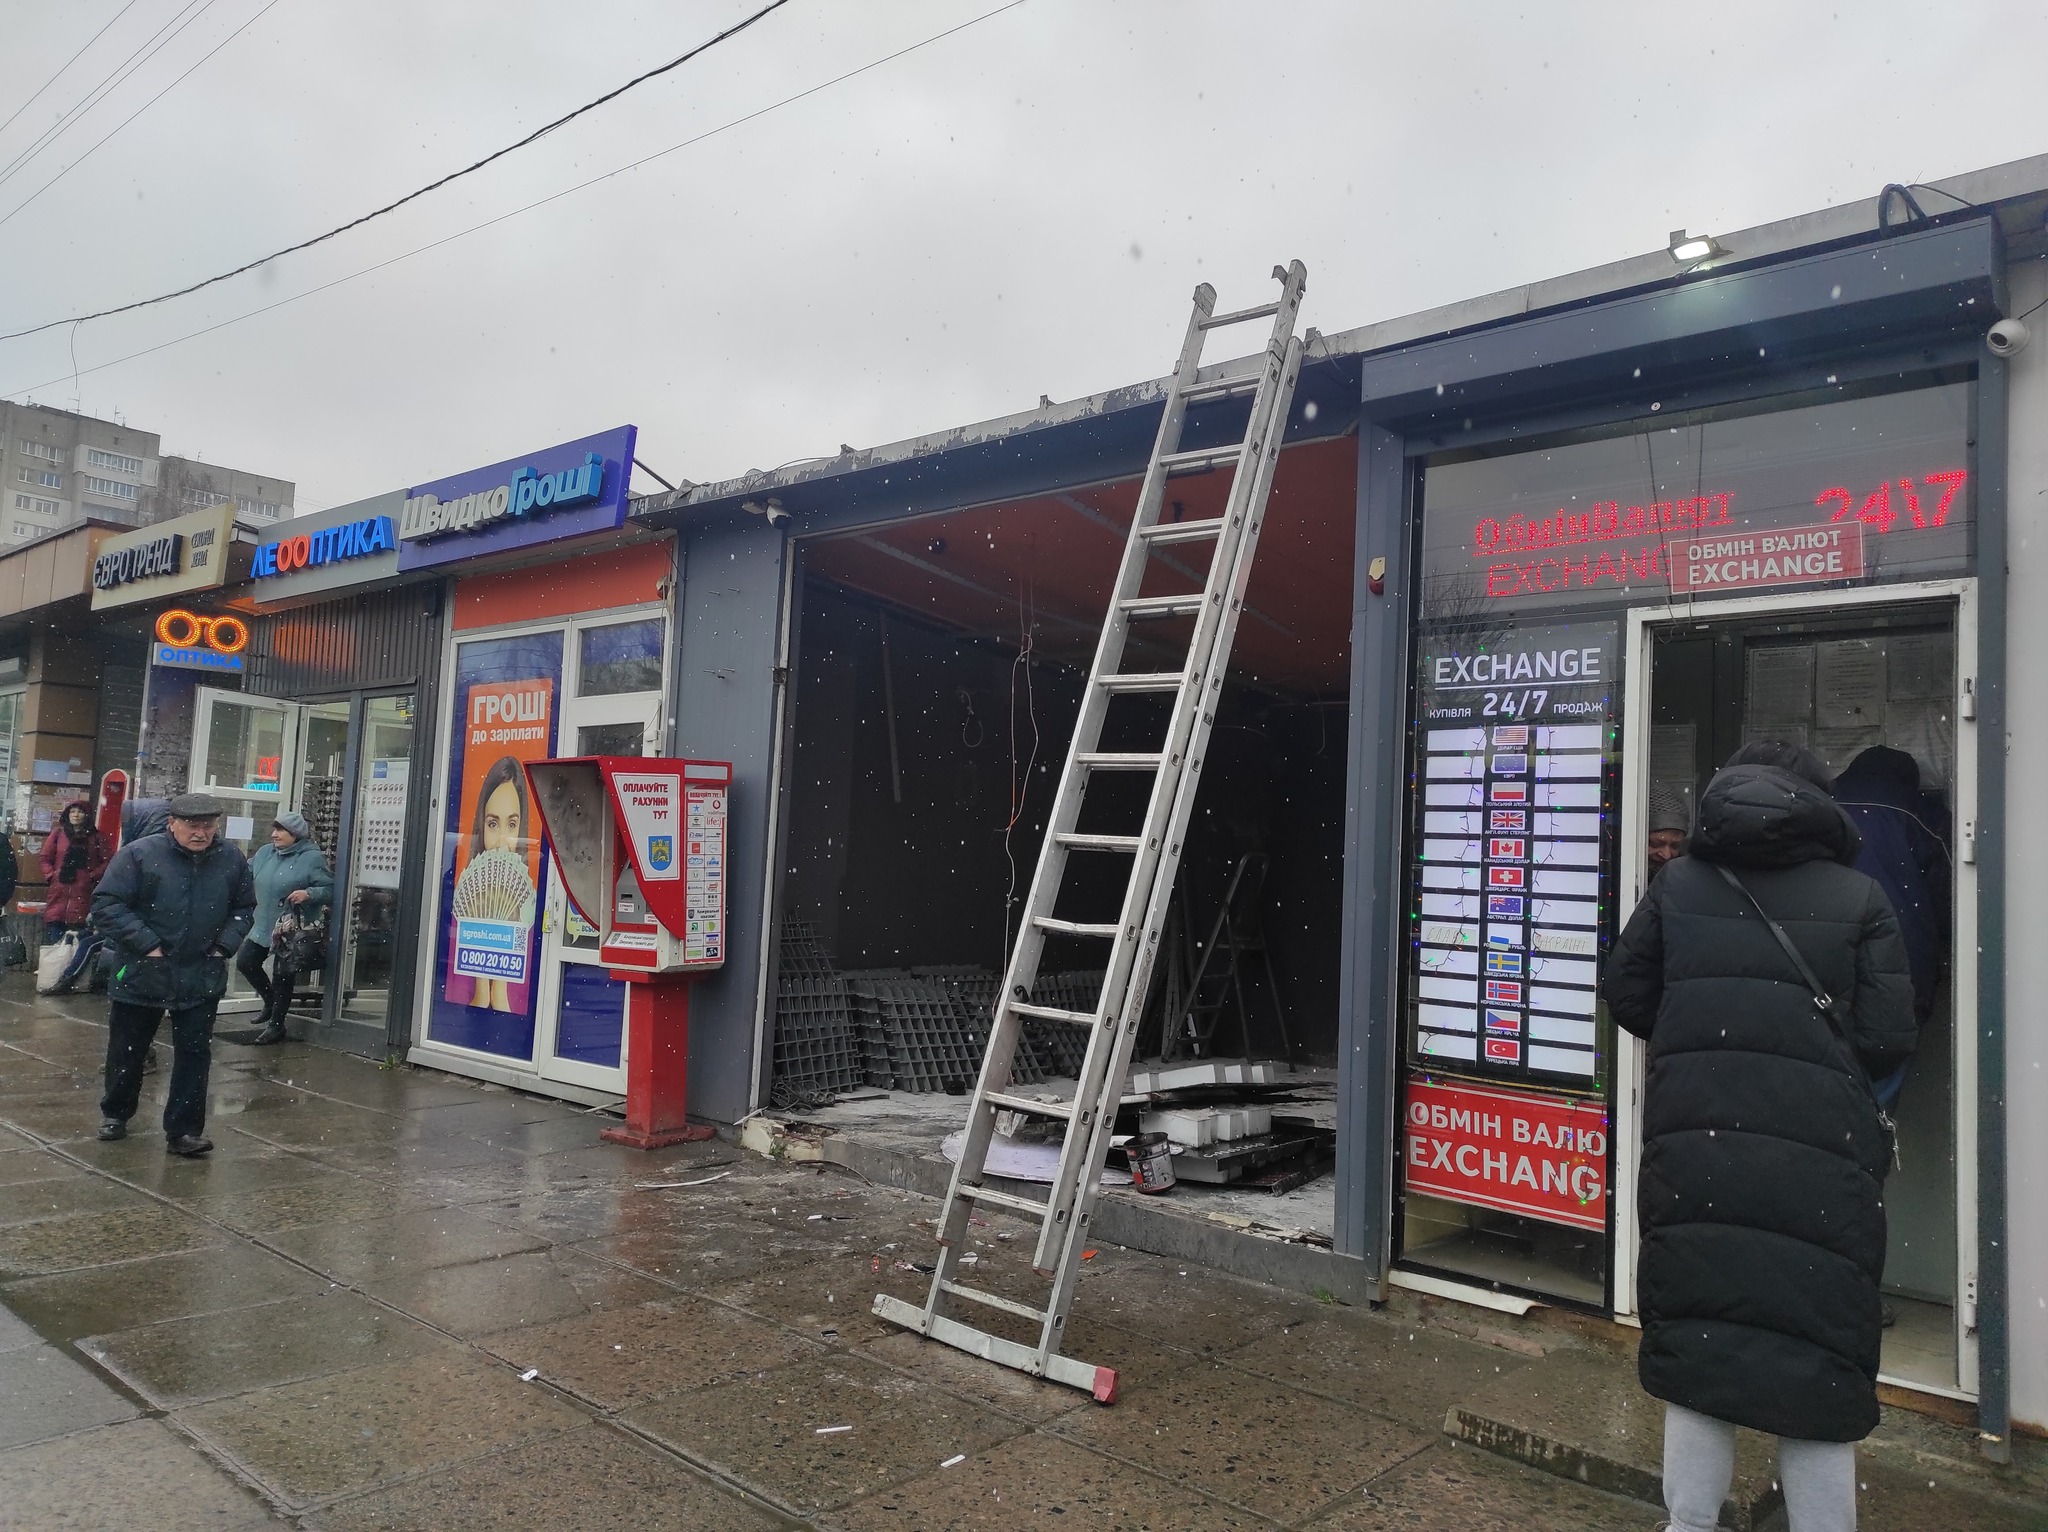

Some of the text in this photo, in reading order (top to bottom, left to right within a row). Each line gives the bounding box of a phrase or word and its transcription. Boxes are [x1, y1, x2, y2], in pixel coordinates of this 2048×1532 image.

[399, 452, 602, 542] ШвидкоГроші
[1687, 530, 1842, 561] ОБМІН ВАЛЮТ
[93, 534, 181, 588] ЄВРО ТРЕНД
[1687, 551, 1844, 586] EXCHANGE
[160, 648, 243, 669] ОПТИКА
[1435, 648, 1601, 684] EXCHANGE
[473, 690, 546, 724] ГРОШІ
[1429, 707, 1472, 719] КУПІВЛЯ
[1483, 690, 1548, 716] 24/7
[1553, 702, 1603, 715] ПРОДАЖ
[471, 726, 545, 745] до зарплати
[623, 782, 669, 793] ОПЛАЧУЙТЕ
[632, 797, 669, 806] РАХУНКИ
[652, 810, 669, 820] ТУТ
[461, 950, 468, 964] 0
[469, 951, 486, 966] 800
[486, 953, 498, 968] 20
[499, 955, 510, 969] 10
[510, 956, 523, 971] 50
[1409, 1101, 1502, 1139] ОБМІН
[1409, 1135, 1602, 1202] EXCHANG
